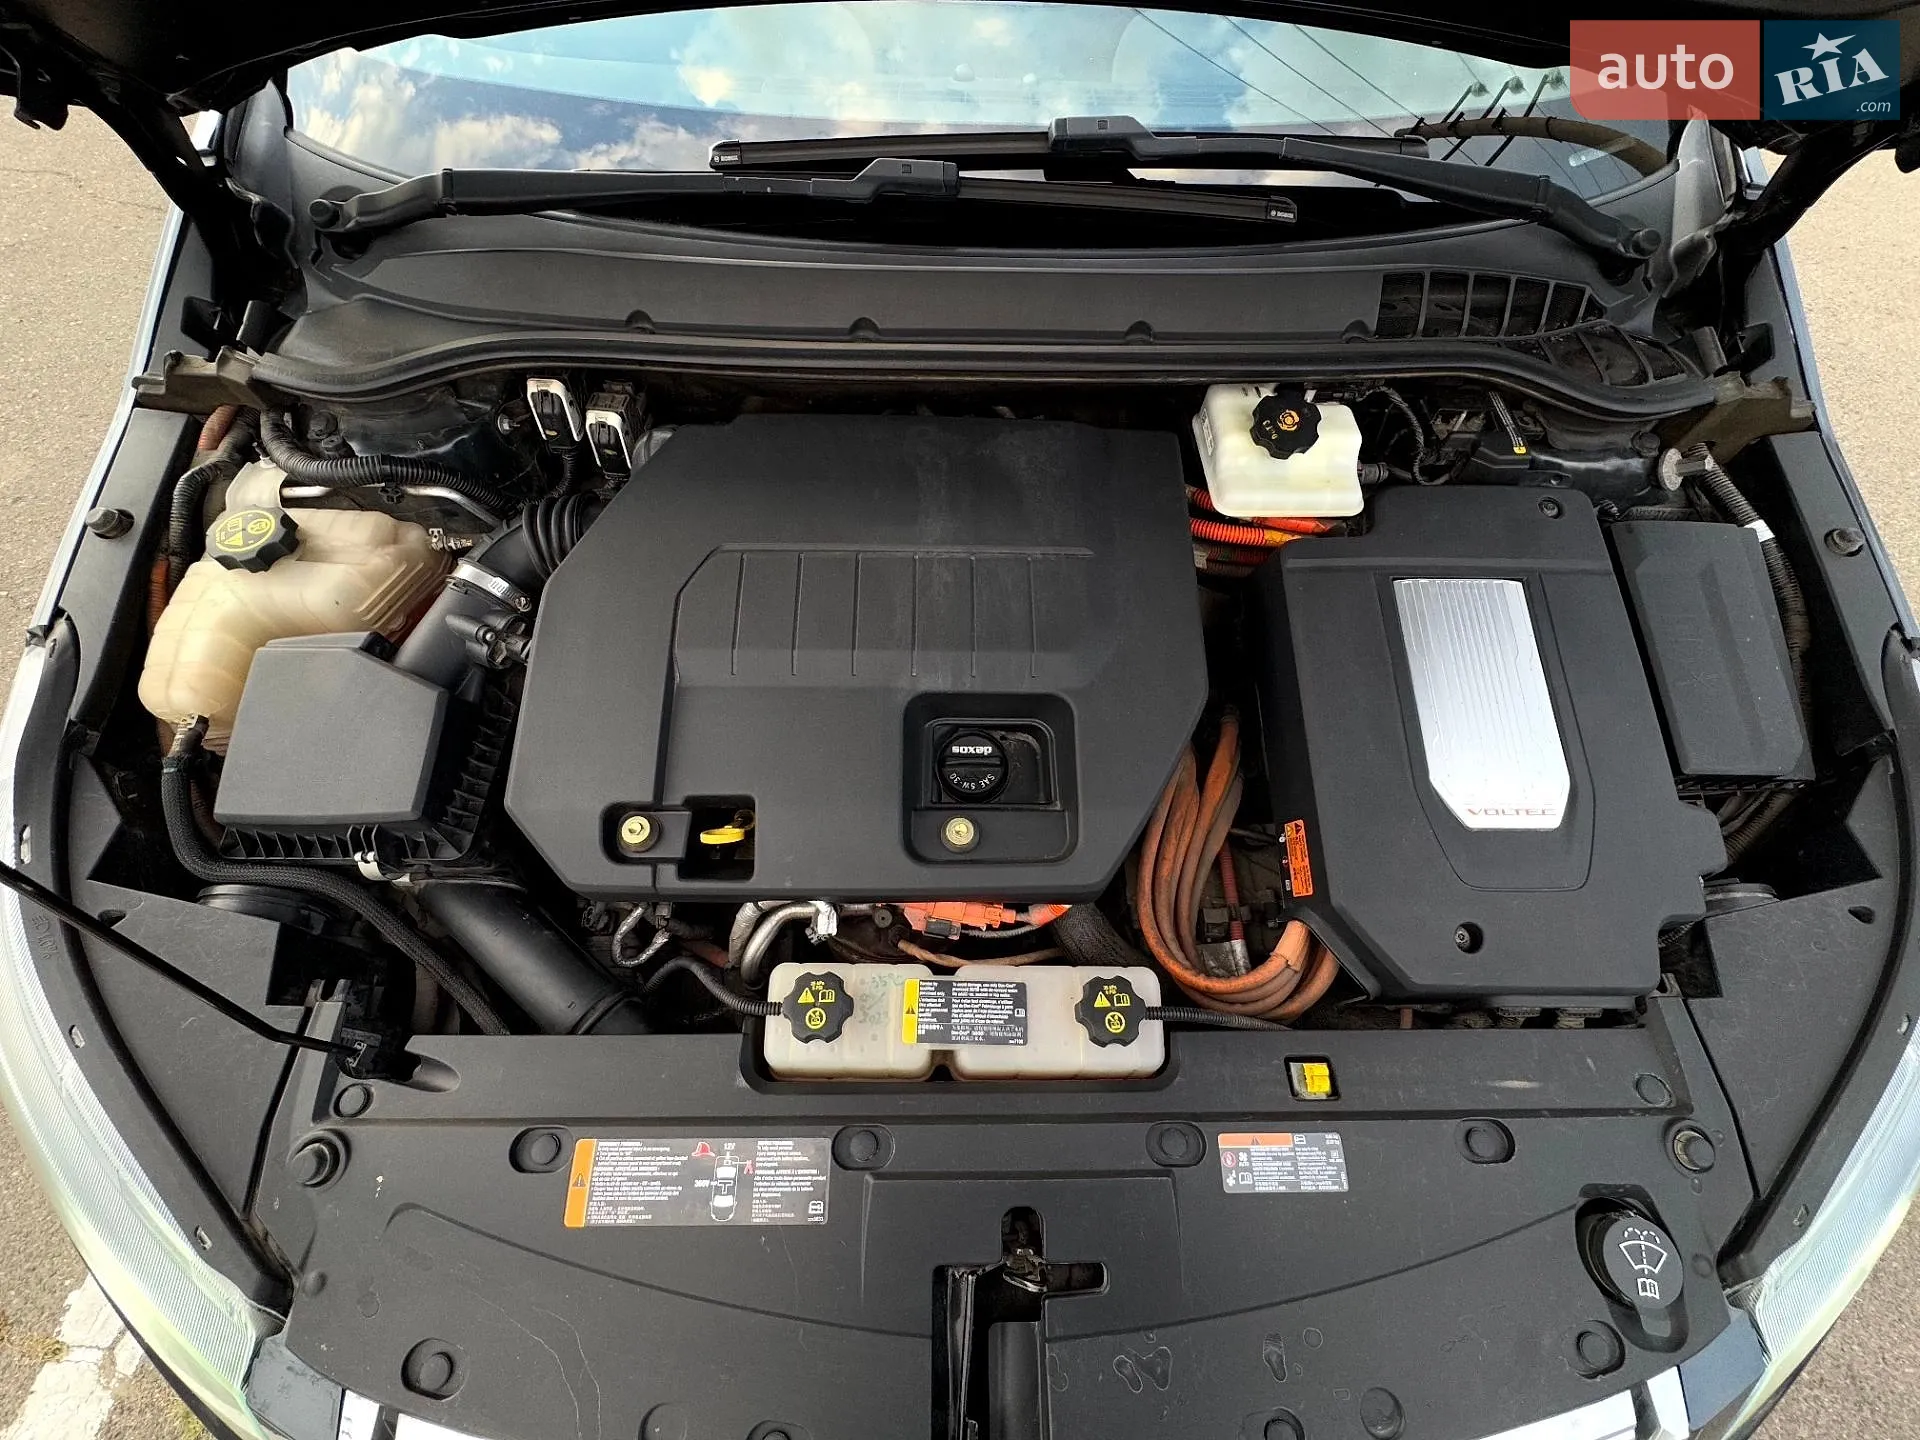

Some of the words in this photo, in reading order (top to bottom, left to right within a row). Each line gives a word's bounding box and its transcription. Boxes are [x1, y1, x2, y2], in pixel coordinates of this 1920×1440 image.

[952, 746, 992, 756] dexos
[979, 773, 995, 789] SAE
[1467, 808, 1556, 816] VOLTEC
